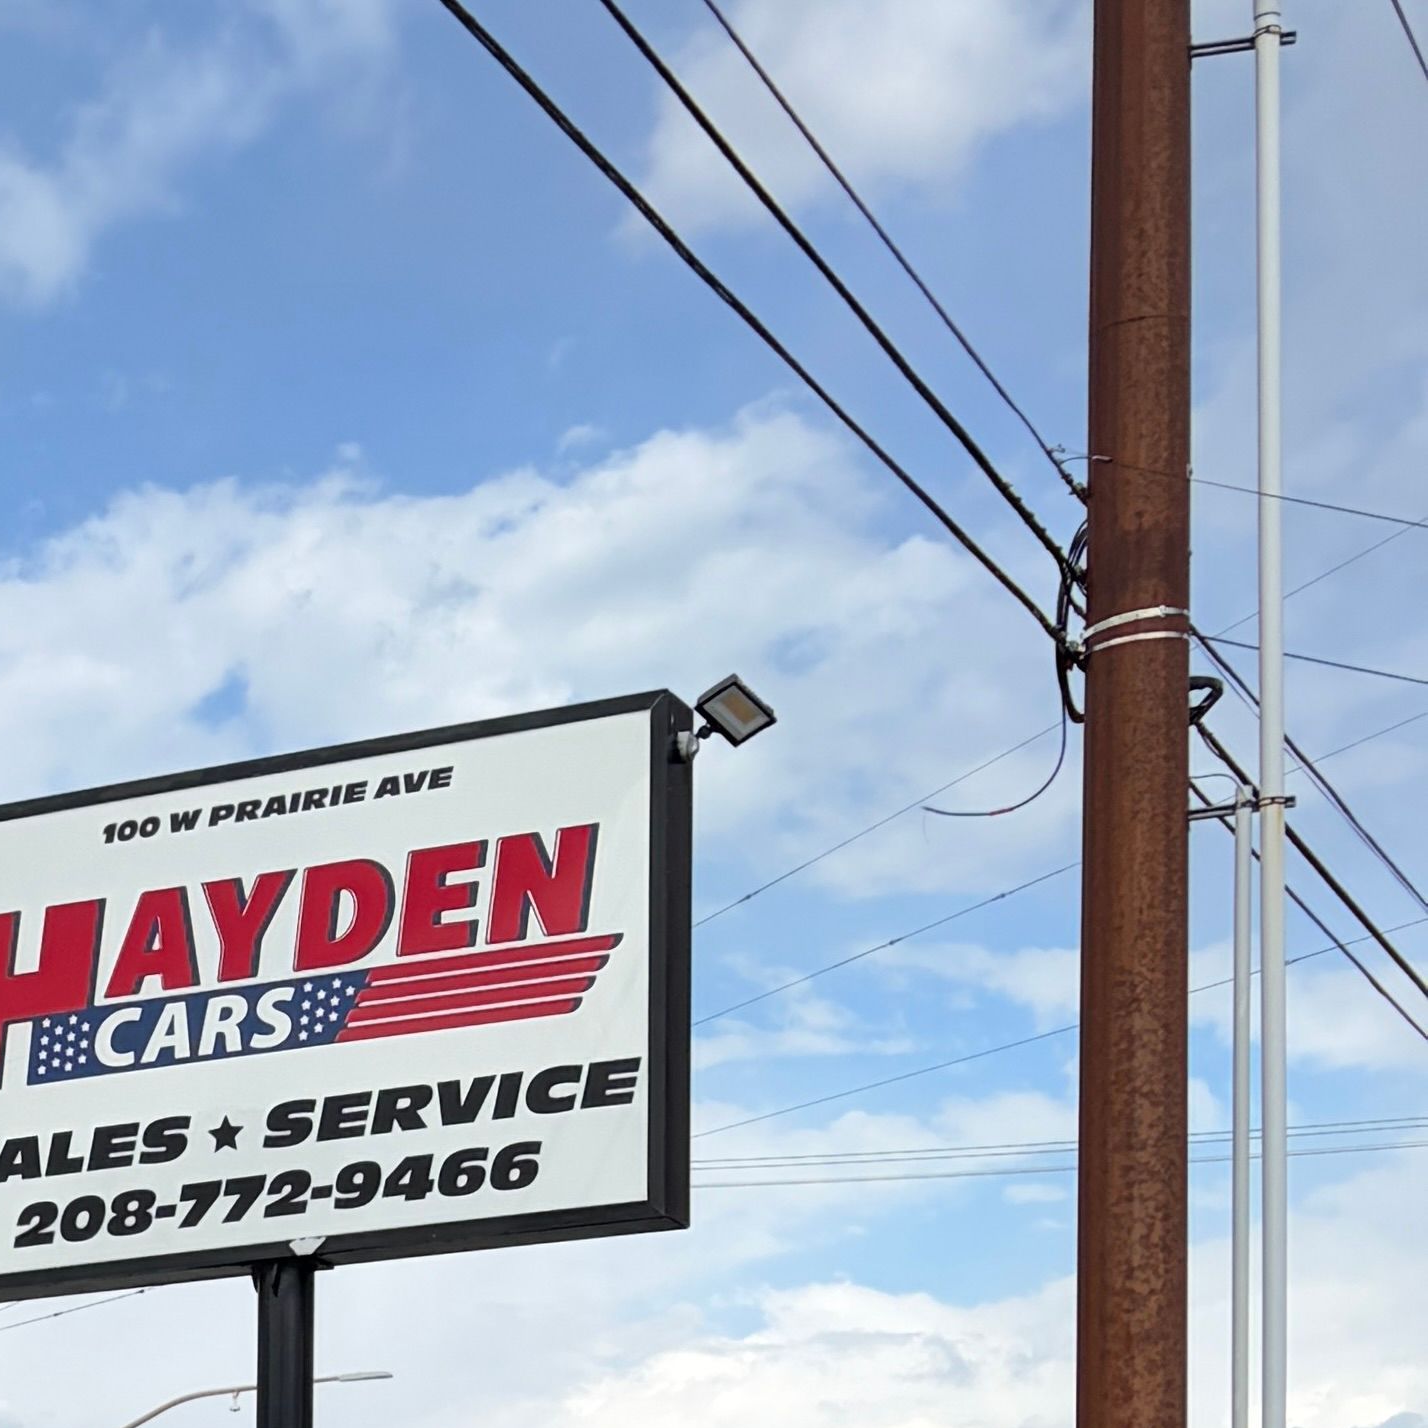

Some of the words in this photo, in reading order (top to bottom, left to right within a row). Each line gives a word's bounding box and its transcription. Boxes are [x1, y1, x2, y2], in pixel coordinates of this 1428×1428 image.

[102, 815, 161, 845] 100
[169, 807, 206, 834] W
[208, 780, 368, 828] PRAIRIE
[373, 765, 455, 801] AVE
[93, 984, 297, 1069] CARS
[262, 1056, 643, 1149] SERVICE
[14, 1140, 542, 1249] 208-772-9466
